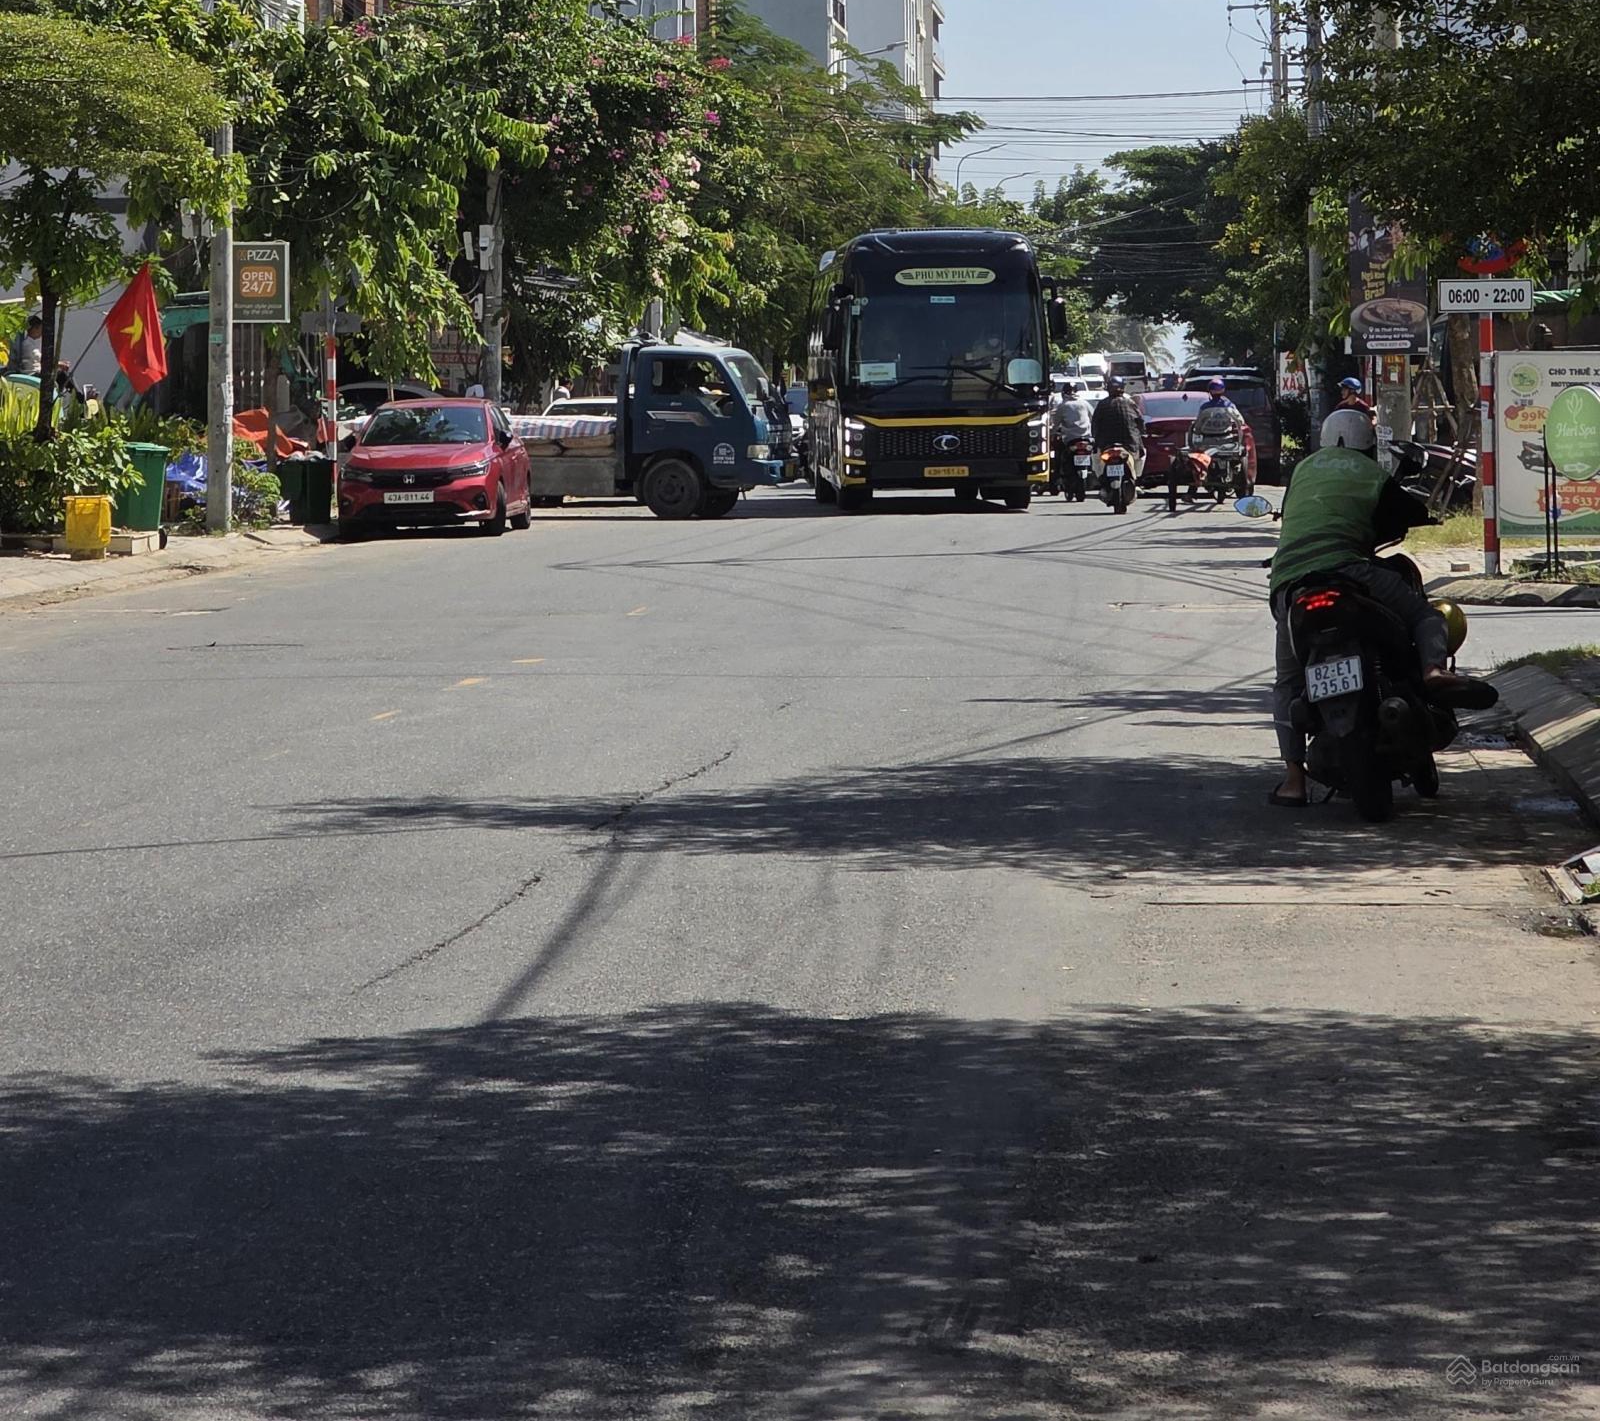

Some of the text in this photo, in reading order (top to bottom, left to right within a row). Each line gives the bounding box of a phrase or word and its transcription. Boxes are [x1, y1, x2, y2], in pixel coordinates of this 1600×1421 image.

[242, 271, 273, 281] OPEN
[242, 281, 273, 294] 24/7
[1448, 289, 1479, 303] 06:00
[1493, 289, 1524, 303] 22:00
[1549, 368, 1567, 376] CHO
[1521, 410, 1546, 421] 99K
[1579, 424, 1597, 439] Spa
[1314, 660, 1351, 681] 82-E1
[1311, 674, 1358, 699] 235.61
